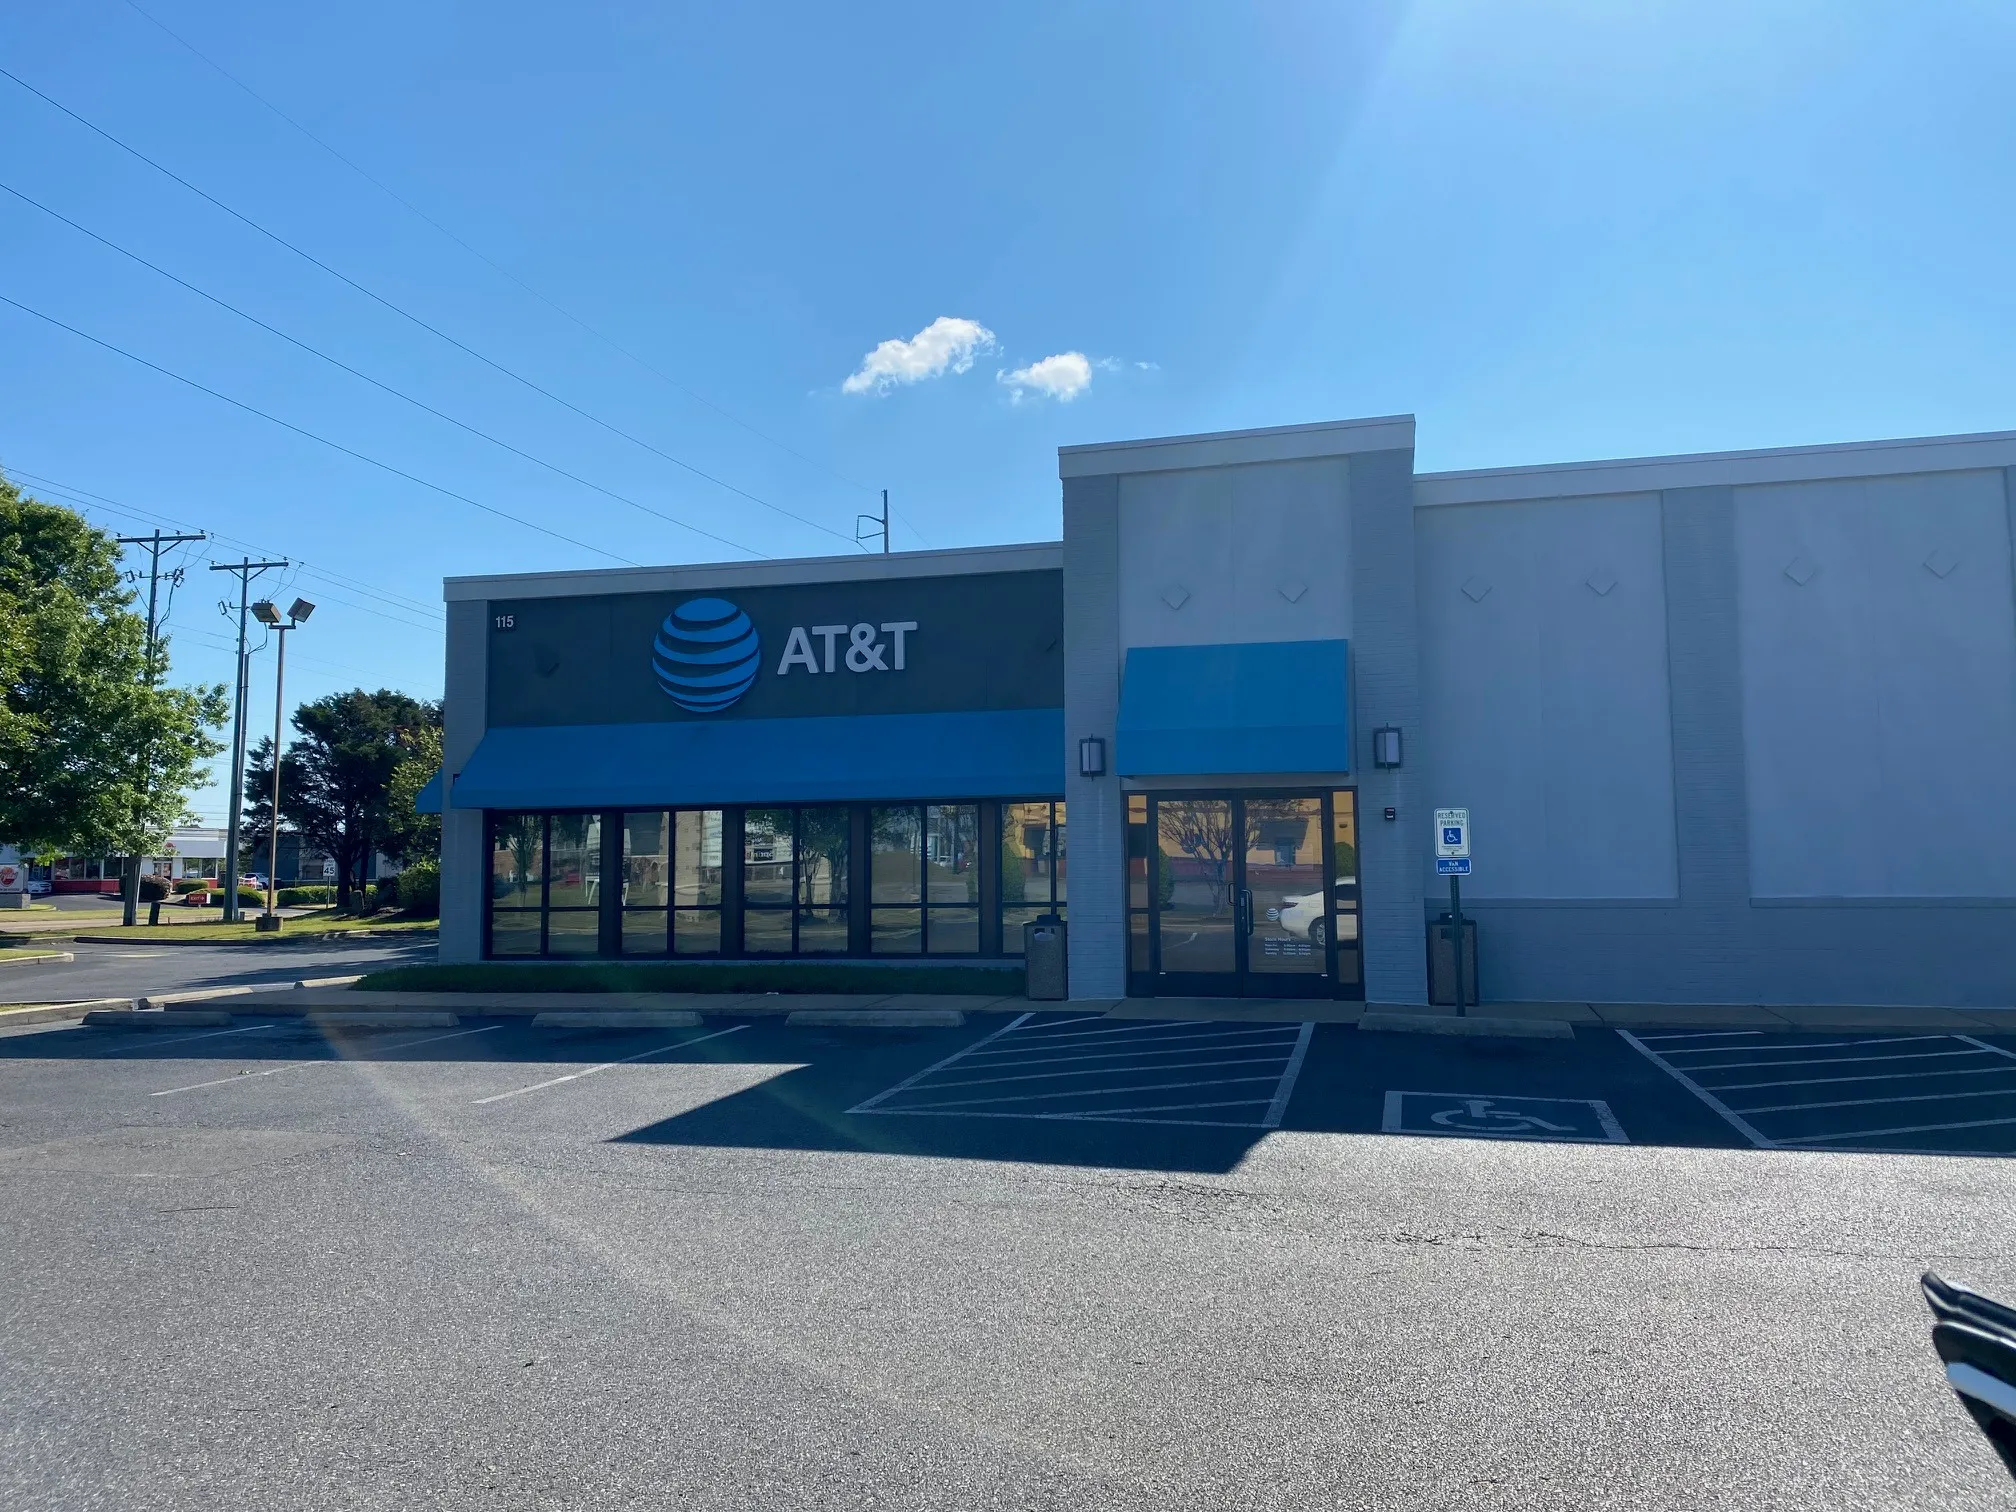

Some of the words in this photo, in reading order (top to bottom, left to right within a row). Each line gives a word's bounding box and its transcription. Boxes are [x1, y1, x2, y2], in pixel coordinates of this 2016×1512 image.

[495, 615, 514, 628] 115
[777, 621, 918, 675] AT&T
[323, 867, 335, 875] 45
